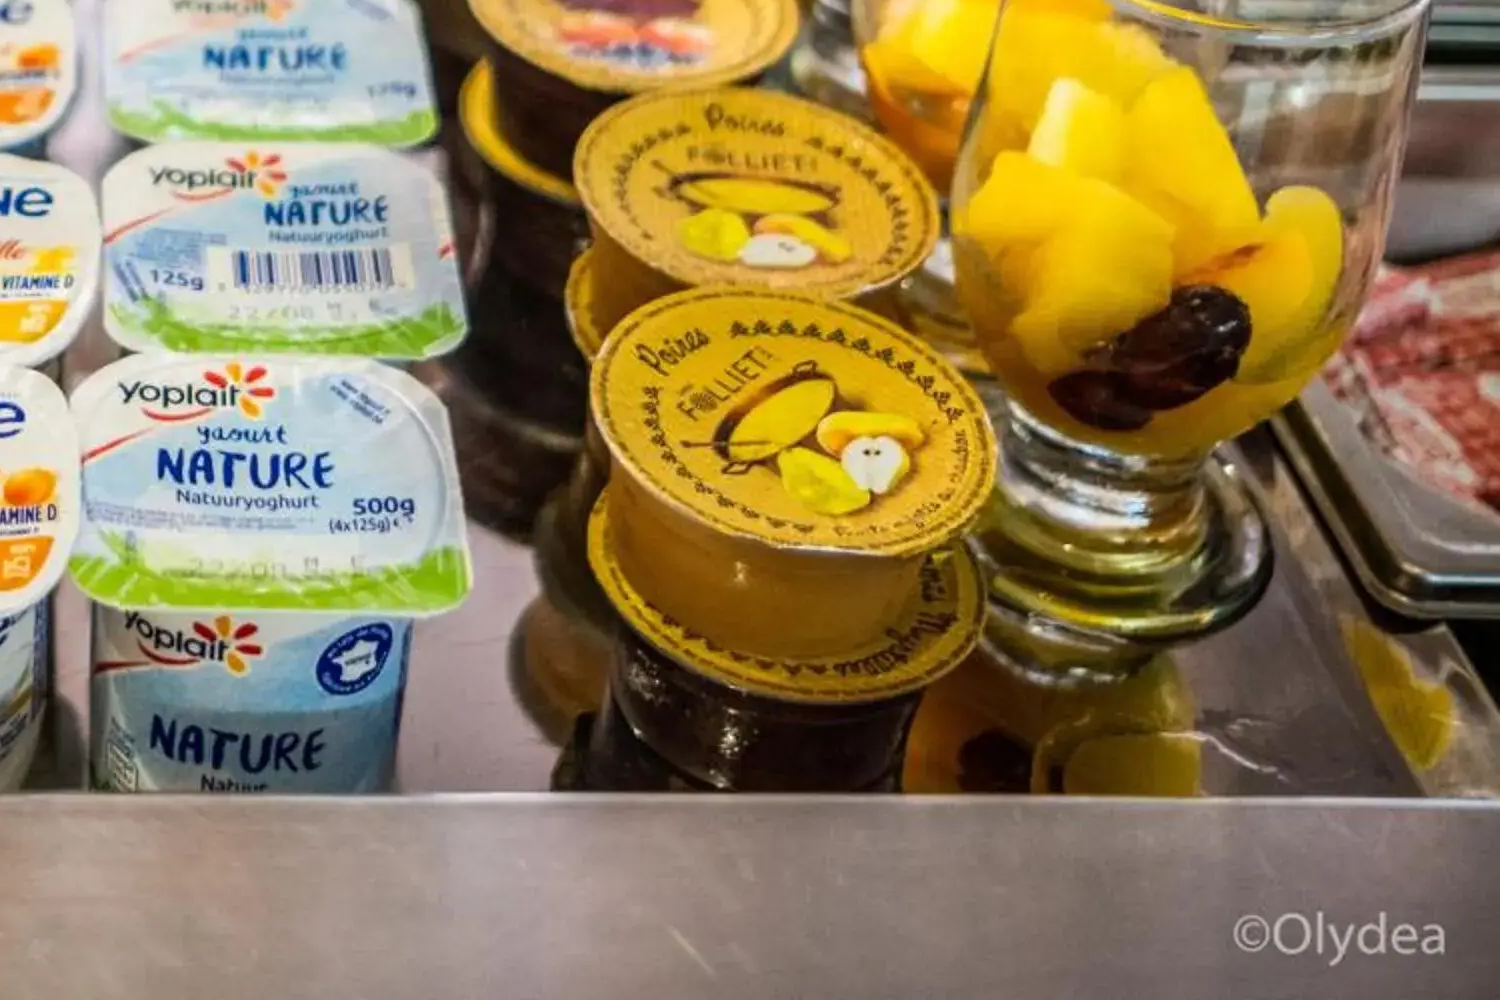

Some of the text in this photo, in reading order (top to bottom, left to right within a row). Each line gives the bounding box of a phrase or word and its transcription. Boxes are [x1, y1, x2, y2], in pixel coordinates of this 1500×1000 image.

[203, 42, 346, 71] NATURE
[149, 165, 258, 190] Yoplait
[264, 195, 389, 226] NATURE
[2, 273, 60, 290] VITAMINE
[150, 269, 203, 291] 125g
[635, 328, 711, 377] Poires
[118, 380, 242, 409] Yoplait
[195, 424, 288, 444] yaourt
[156, 447, 336, 489] NATURE
[47, 503, 57, 521] D
[175, 488, 320, 512] Natuuryoghurt
[353, 495, 416, 517] 500g
[328, 518, 391, 534] (4x125g)
[124, 609, 231, 661] Yoplait
[149, 713, 328, 774] NATURE
